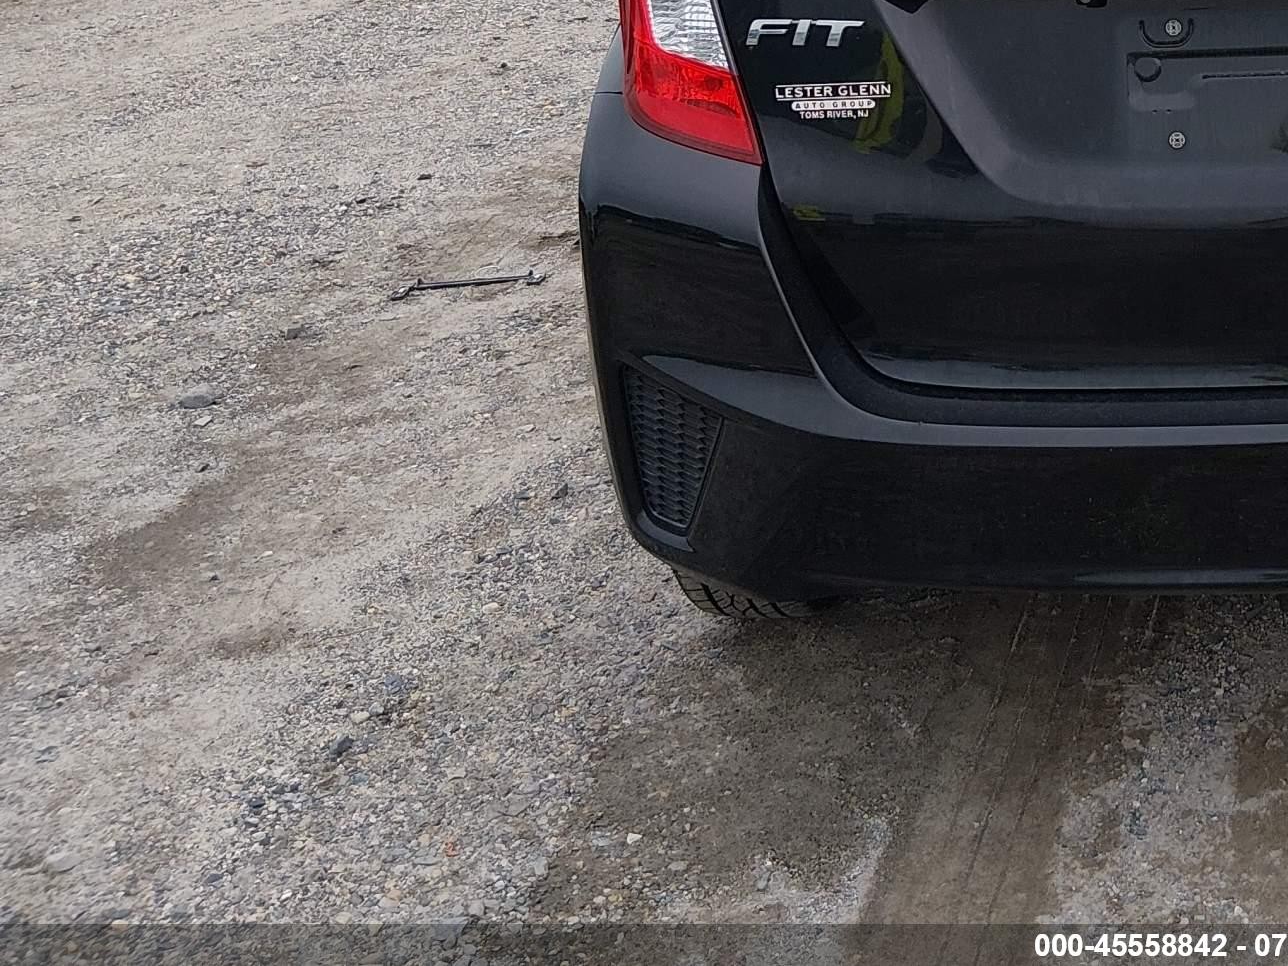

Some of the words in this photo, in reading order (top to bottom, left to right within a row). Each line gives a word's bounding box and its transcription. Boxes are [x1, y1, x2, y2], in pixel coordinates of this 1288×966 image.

[745, 18, 865, 47] FIT
[775, 85, 833, 99] LESTER
[838, 84, 891, 96] GLENN
[795, 101, 825, 109] AUTO
[832, 100, 872, 108] GROUP
[800, 111, 825, 119] TOMS
[826, 110, 856, 119] RIVER,
[857, 109, 869, 117] NJ
